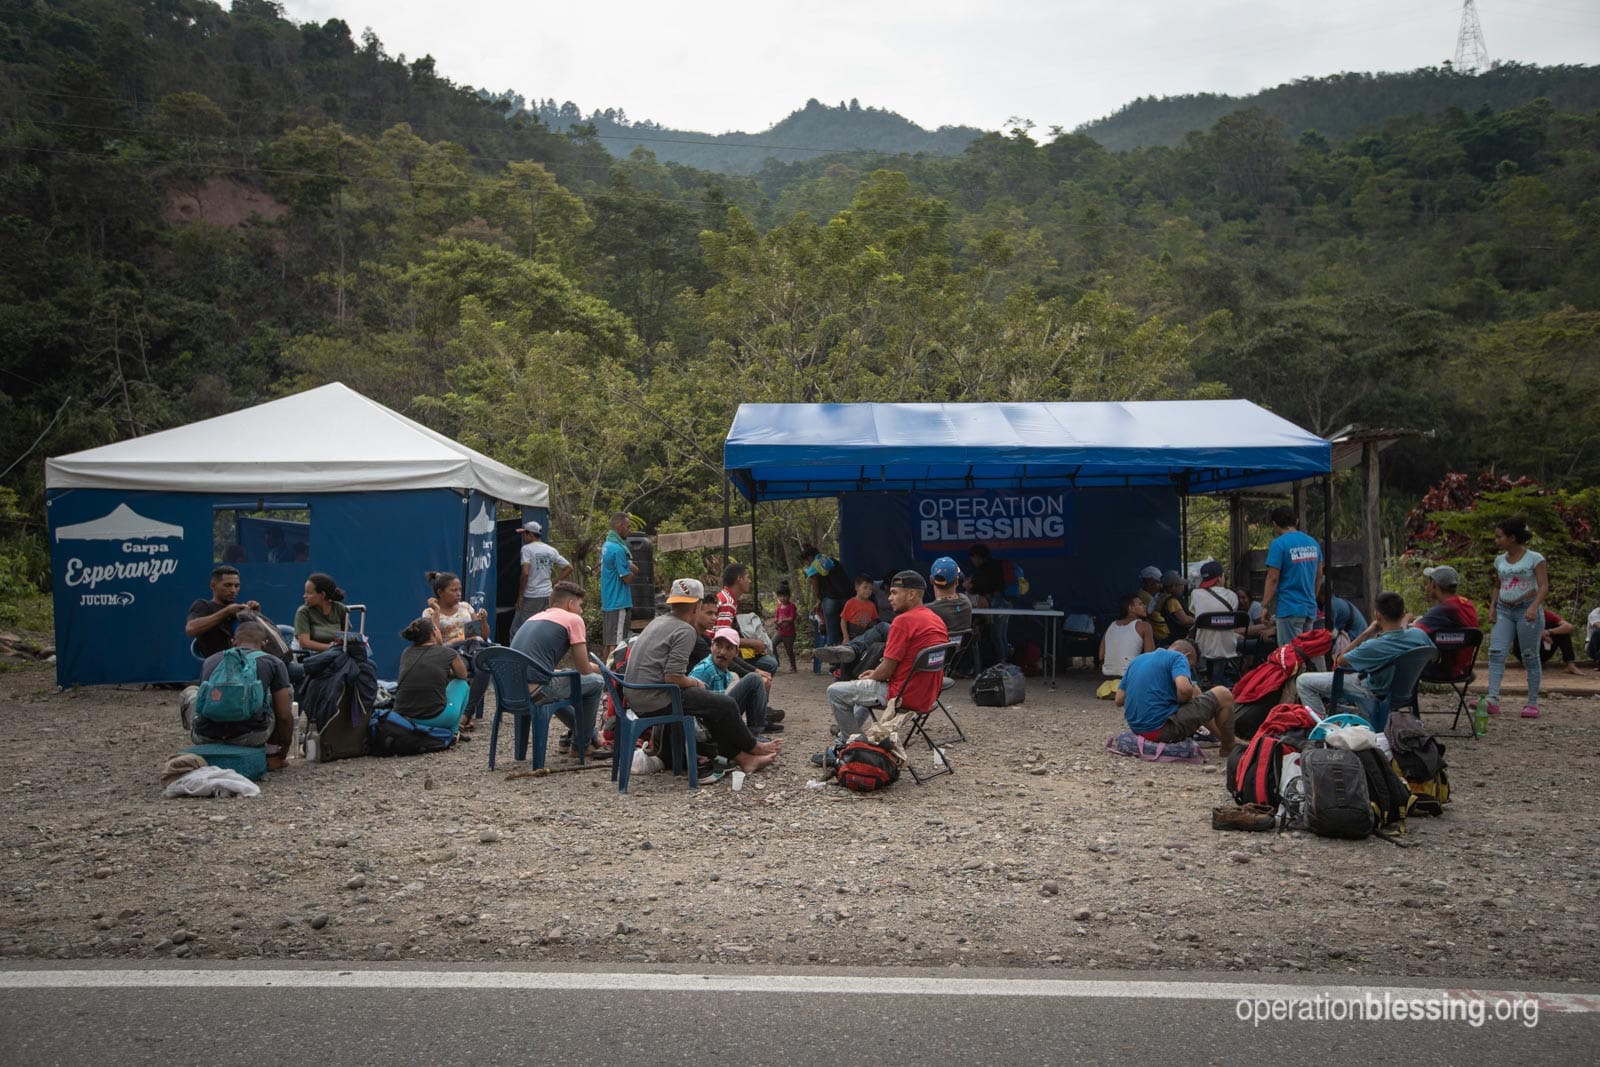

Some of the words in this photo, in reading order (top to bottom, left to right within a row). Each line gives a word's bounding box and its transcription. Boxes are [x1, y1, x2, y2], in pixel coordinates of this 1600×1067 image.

[919, 495, 1064, 518] OPERATION
[920, 516, 1065, 541] BLESSING
[122, 542, 169, 555] Carpa
[65, 558, 178, 589] Esperanza
[80, 594, 119, 606] JUCUM
